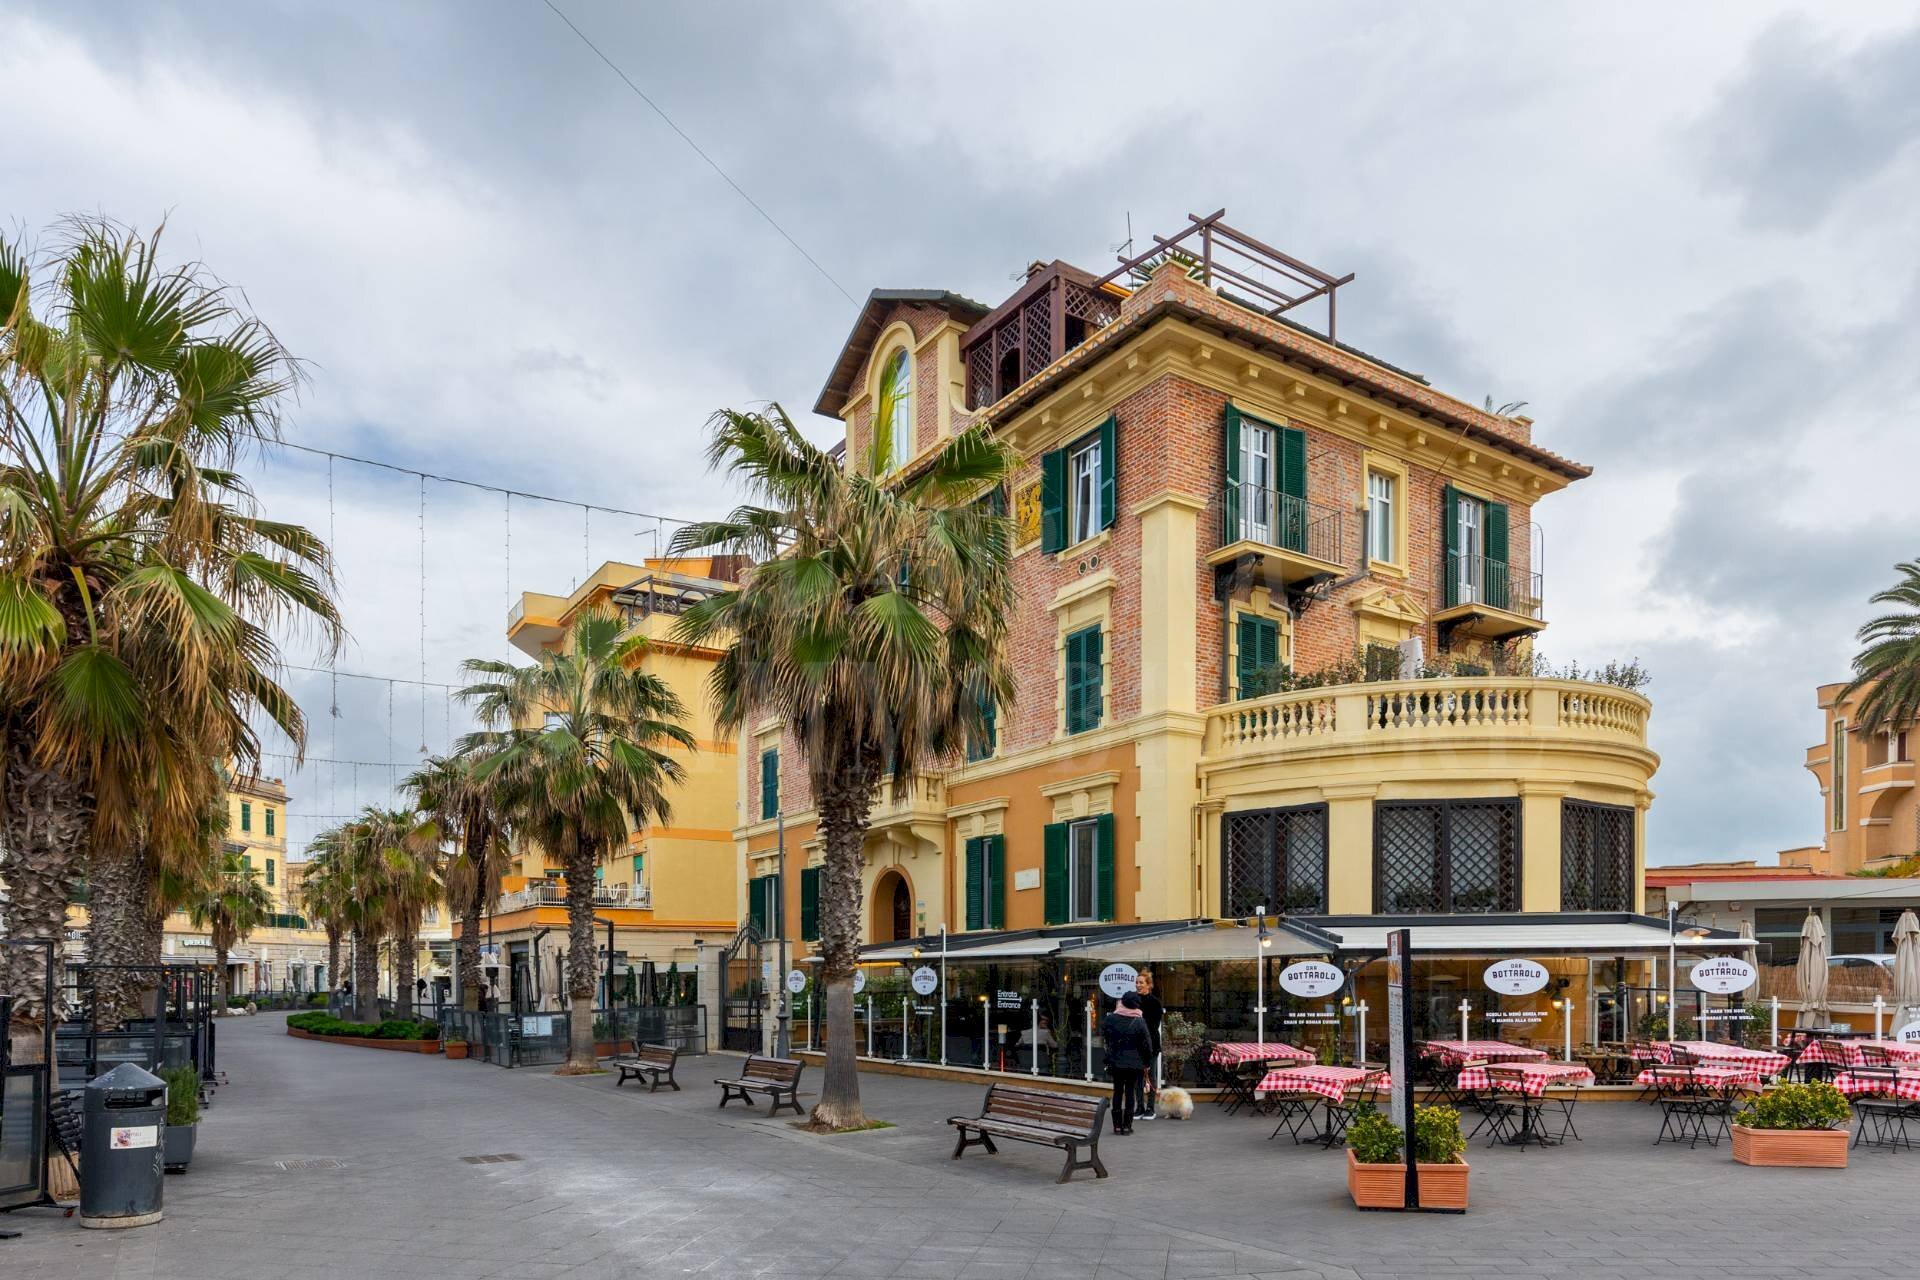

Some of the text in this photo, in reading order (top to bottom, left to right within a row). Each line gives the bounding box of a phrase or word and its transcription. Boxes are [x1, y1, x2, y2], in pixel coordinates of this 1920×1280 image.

[1287, 971, 1336, 980] BOTTAROLO
[1492, 969, 1541, 978] BOTTAROLO
[1699, 967, 1748, 977] BOTTAROLO
[997, 989, 1018, 998] Entrata
[997, 1000, 1021, 1009] Entrance
